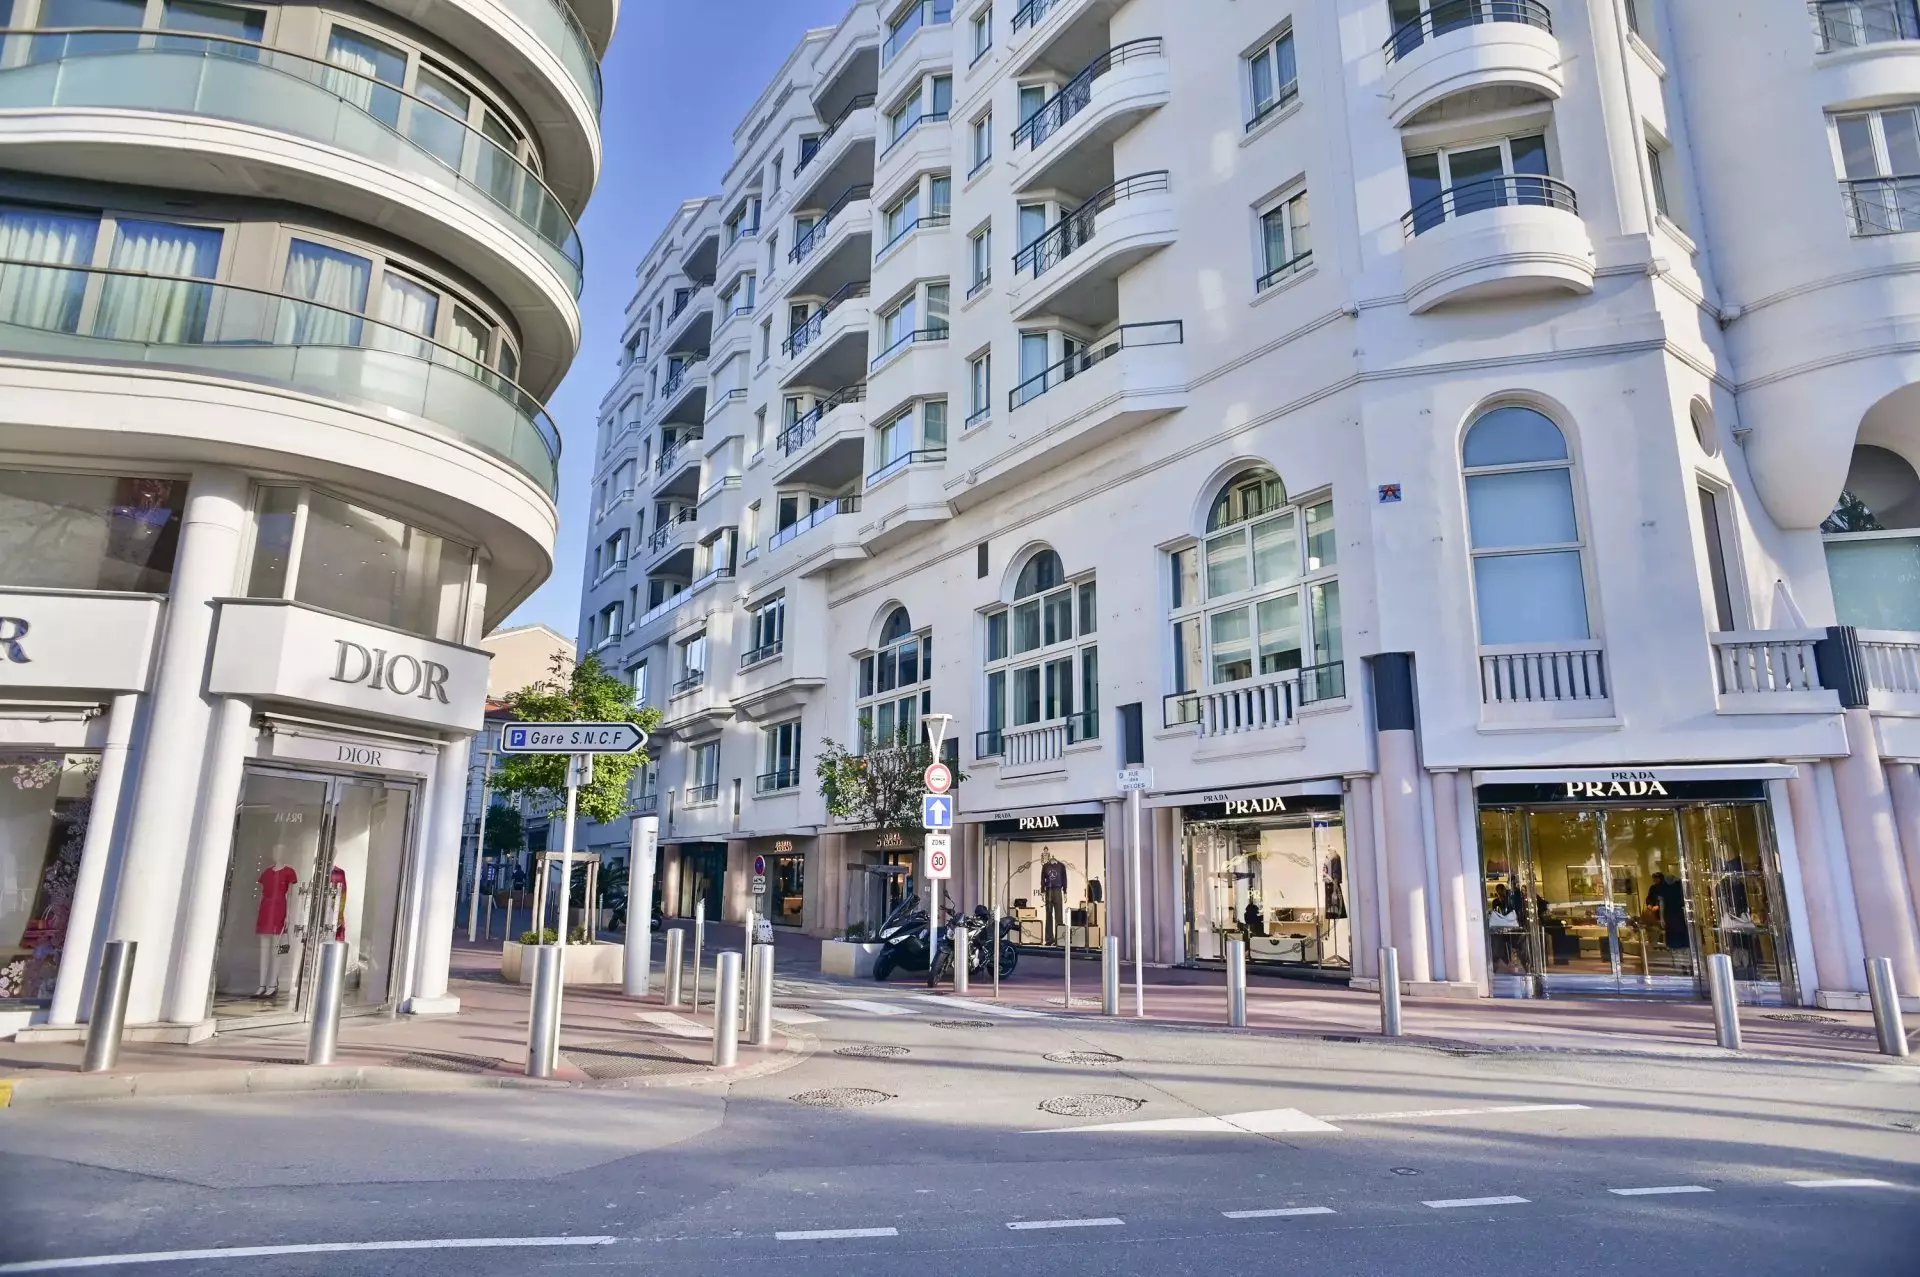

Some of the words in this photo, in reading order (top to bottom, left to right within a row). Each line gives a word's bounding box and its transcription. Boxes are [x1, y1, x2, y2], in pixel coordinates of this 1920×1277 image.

[329, 639, 451, 704] DIOR
[530, 731, 564, 744] Gare
[570, 731, 622, 744] S.N.C.F
[337, 745, 382, 765] DIOR
[1611, 771, 1656, 780] PRADA
[1566, 780, 1668, 797] PRADA
[1203, 793, 1229, 802] PRADA
[1225, 796, 1287, 815] PRADA
[1019, 815, 1059, 829] PRADA
[934, 857, 943, 865] 30
